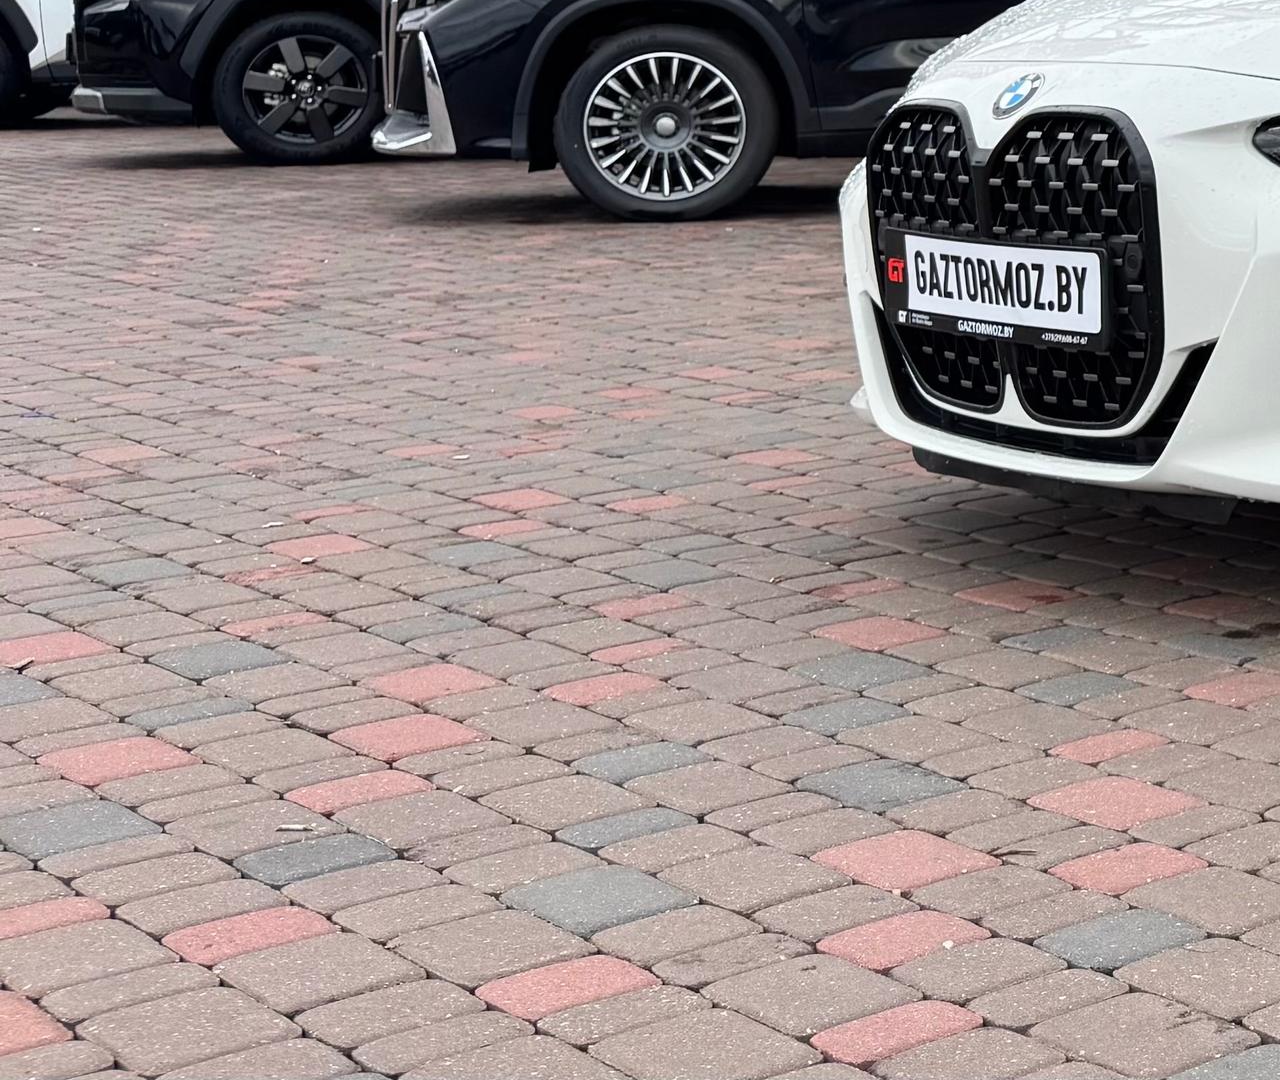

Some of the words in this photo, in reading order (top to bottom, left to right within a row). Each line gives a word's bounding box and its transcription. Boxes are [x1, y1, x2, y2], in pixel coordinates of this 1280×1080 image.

[887, 258, 904, 283] GT
[914, 249, 1087, 315] GAZTORMOZ.BY
[957, 319, 1014, 338] GAZTORMOZ.BY
